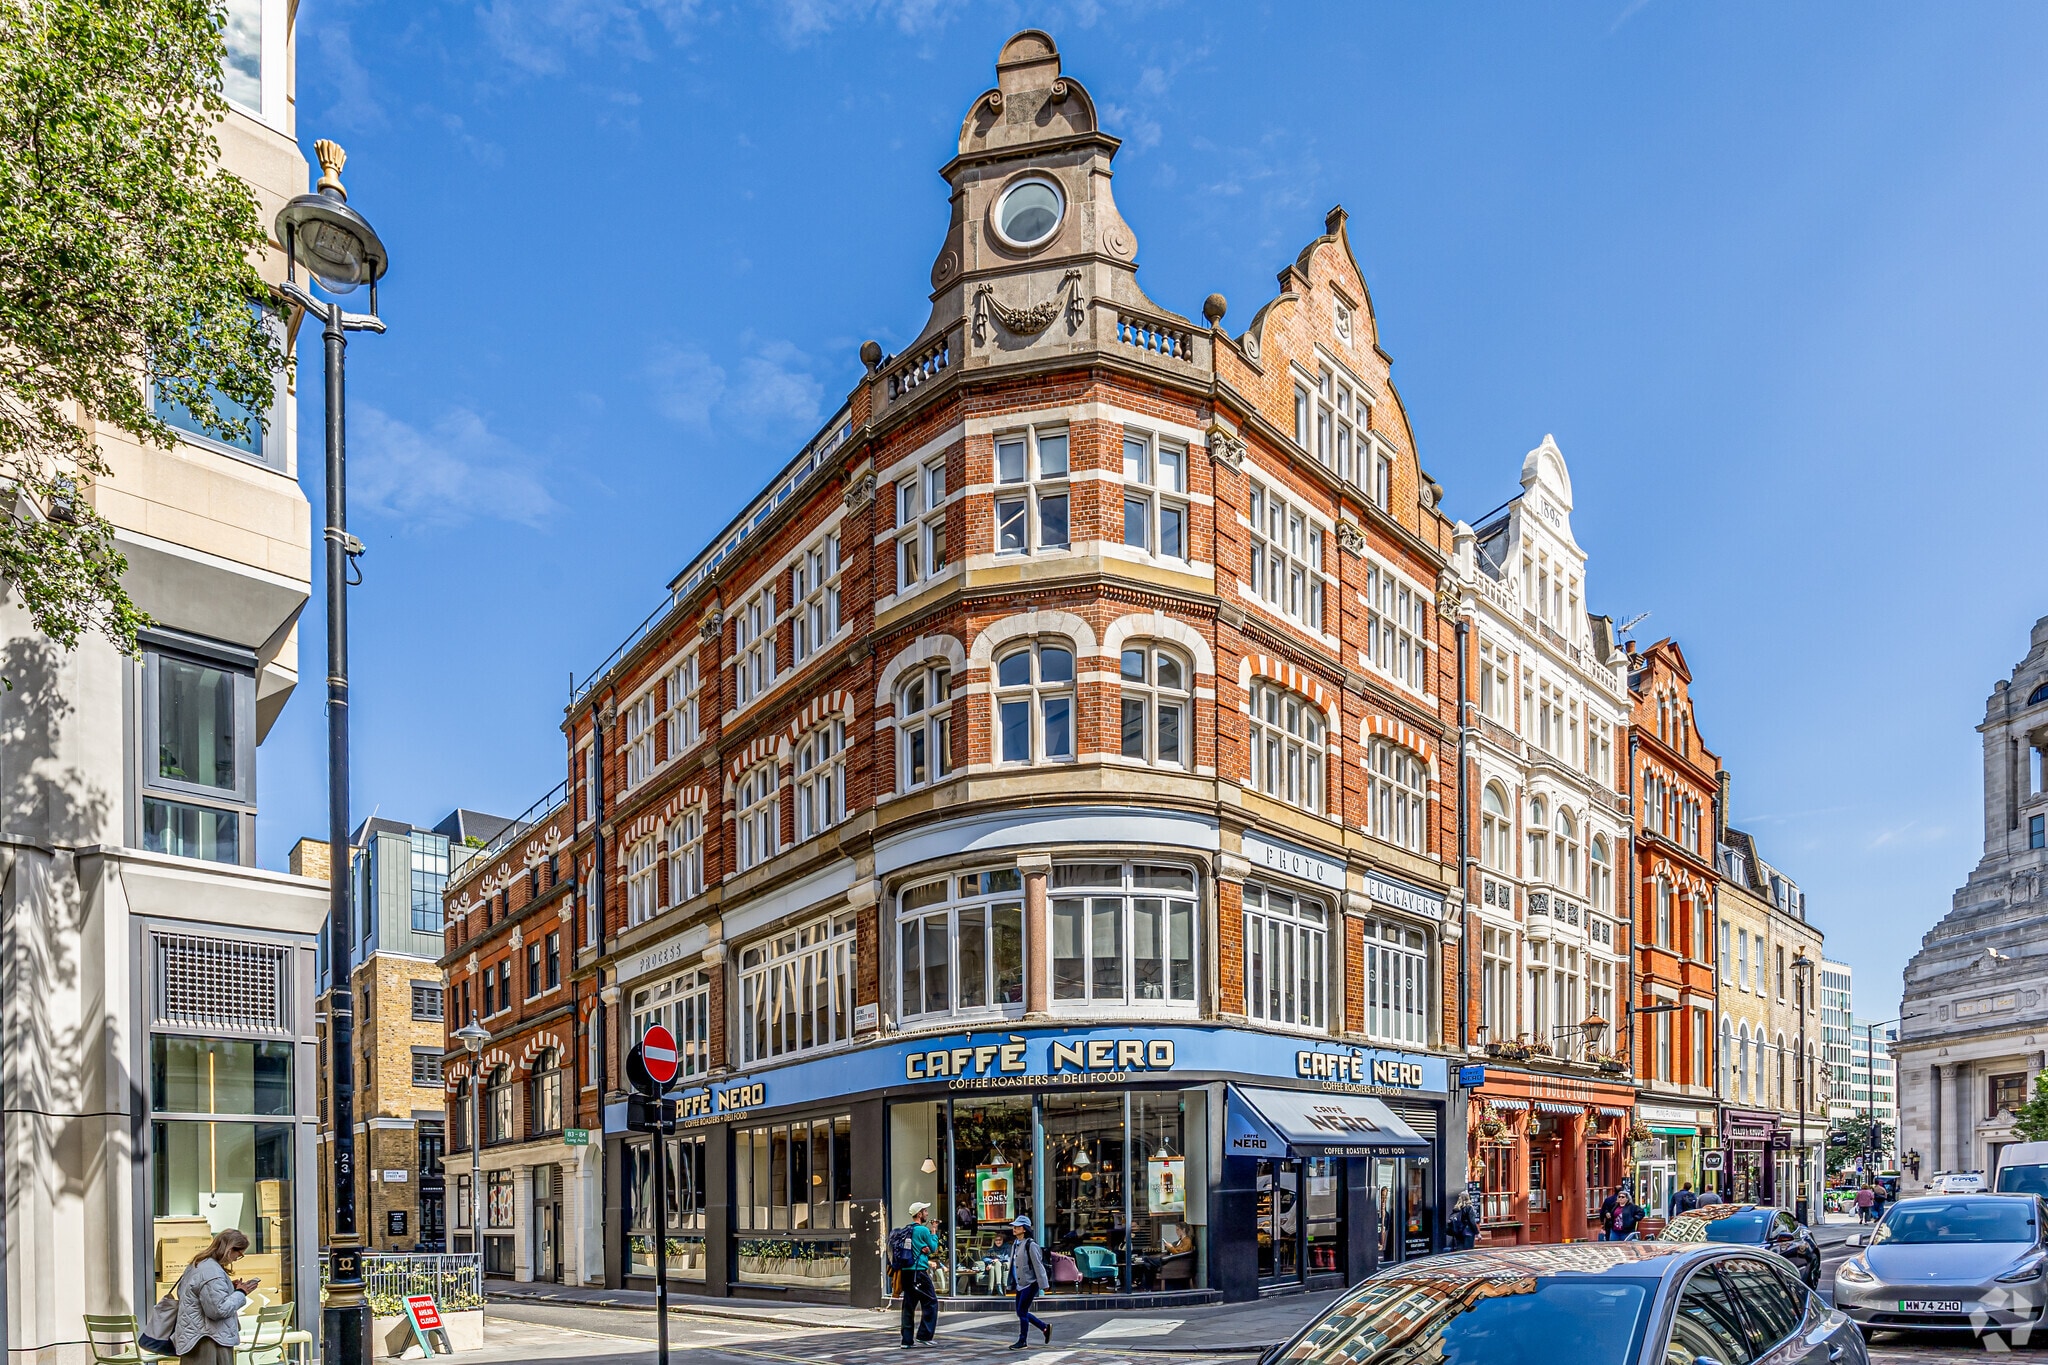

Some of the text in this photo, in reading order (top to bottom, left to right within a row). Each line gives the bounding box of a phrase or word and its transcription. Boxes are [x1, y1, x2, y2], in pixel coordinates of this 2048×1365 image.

[1540, 499, 1560, 528] 1896
[1266, 846, 1324, 881] PHOTO
[1369, 879, 1436, 916] ENGRAVERS
[640, 942, 681, 973] PROCESS
[906, 1034, 1175, 1080] CAFFÈ NERO
[1296, 1049, 1424, 1088] CAFFÈ NERO
[948, 1078, 988, 1090] COFFEE
[991, 1075, 1048, 1088] ROASTERS
[1062, 1072, 1087, 1085] DELI
[1090, 1071, 1126, 1083] FOOD
[1322, 1081, 1344, 1091] COFFEE
[1344, 1083, 1370, 1094] ROASTERS
[1375, 1085, 1386, 1095] DELI
[1386, 1087, 1402, 1096] FOOD
[1528, 1076, 1543, 1097] THE
[675, 1083, 765, 1119] AFFÈ NERO
[684, 1119, 699, 1128] COFFEE
[699, 1115, 720, 1126] ROASTERS
[724, 1114, 733, 1122] DELI
[734, 1111, 748, 1120] FOOD
[1304, 1114, 1382, 1133] NERO
[1233, 1139, 1267, 1149] NERO
[1324, 1147, 1343, 1155] COFFEE
[1347, 1147, 1371, 1155] ROASTERS
[1378, 1147, 1389, 1155] DELI
[983, 1194, 1008, 1202] HONEY
[1906, 1301, 1959, 1311] MW74 ZHO
[420, 1316, 438, 1325] CLOSED
